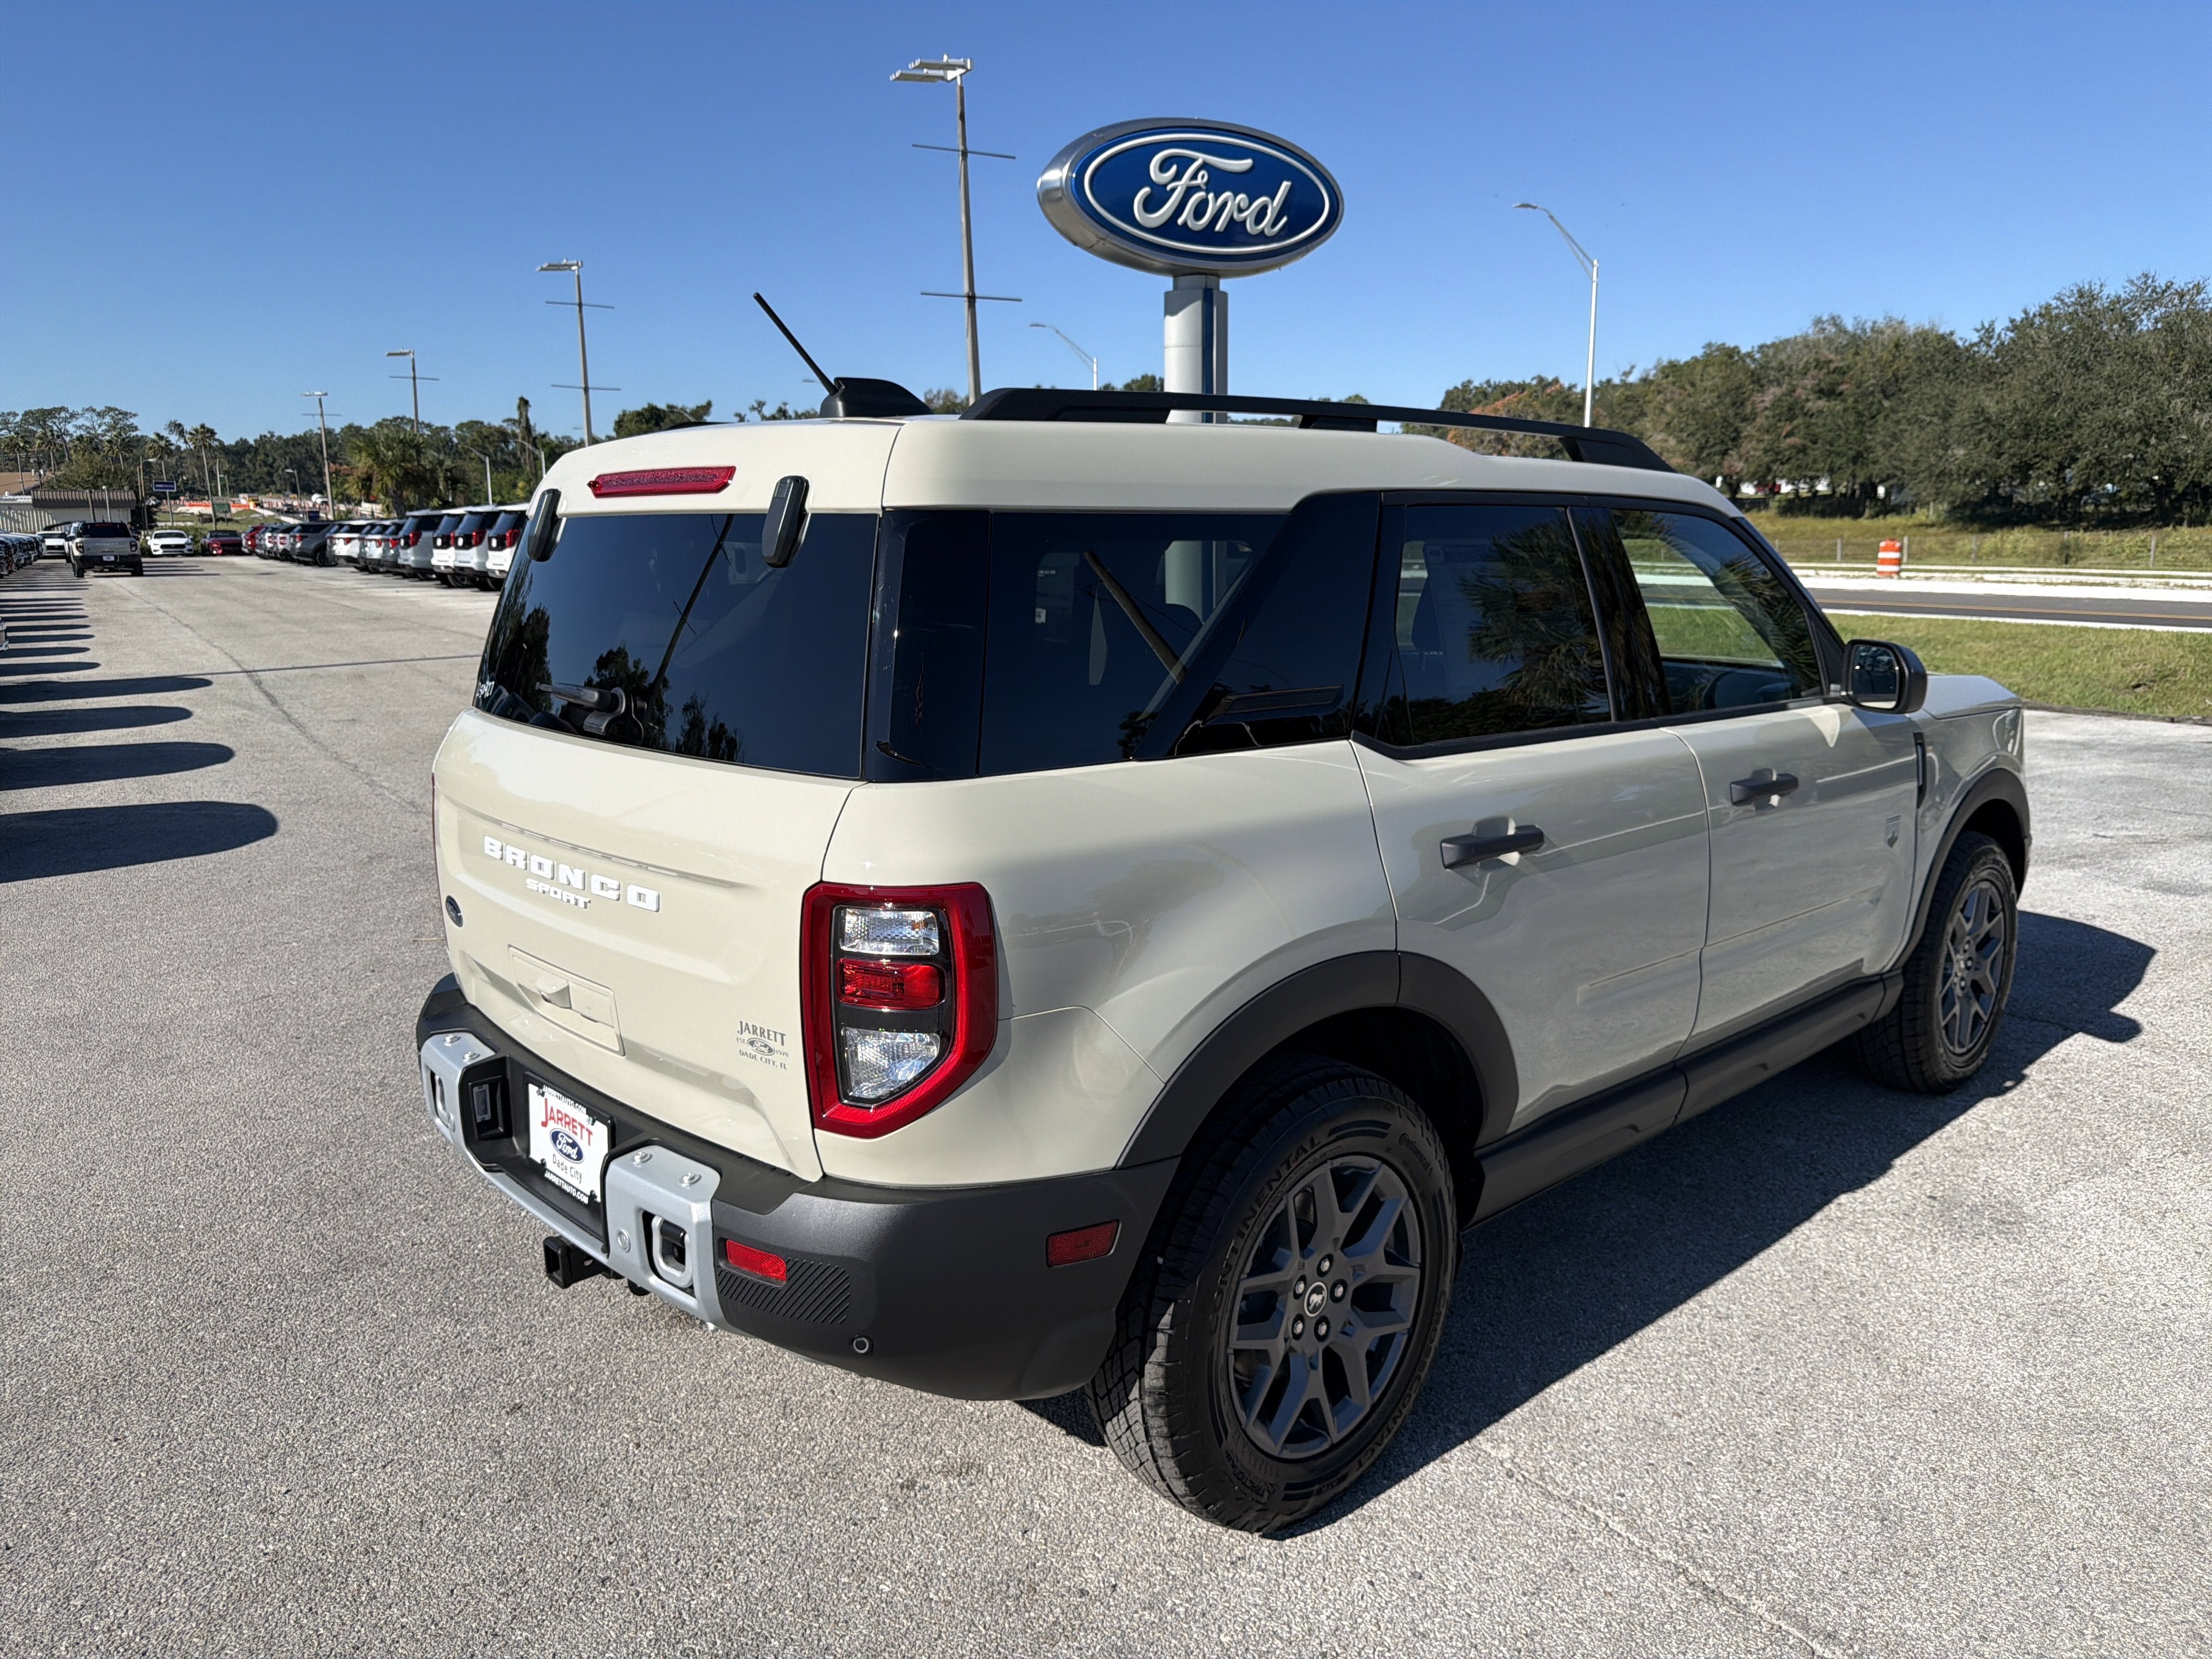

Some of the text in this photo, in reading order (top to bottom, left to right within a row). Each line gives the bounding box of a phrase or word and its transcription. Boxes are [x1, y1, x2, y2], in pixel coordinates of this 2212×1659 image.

[1133, 148, 1293, 237] Ford
[483, 835, 661, 912] BRONCO
[526, 878, 591, 909] SPORT
[737, 1020, 786, 1047] JARRETT
[739, 1049, 758, 1061] DADE
[543, 1084, 587, 1115] JARRETTAUTO.COM
[541, 1097, 593, 1147] JARRETT
[556, 1132, 579, 1160] Ford
[552, 1153, 583, 1184] Dade City
[544, 1169, 589, 1205] JARRETTAUTO.COM
[1209, 1136, 1323, 1335] CONTINENTAL
